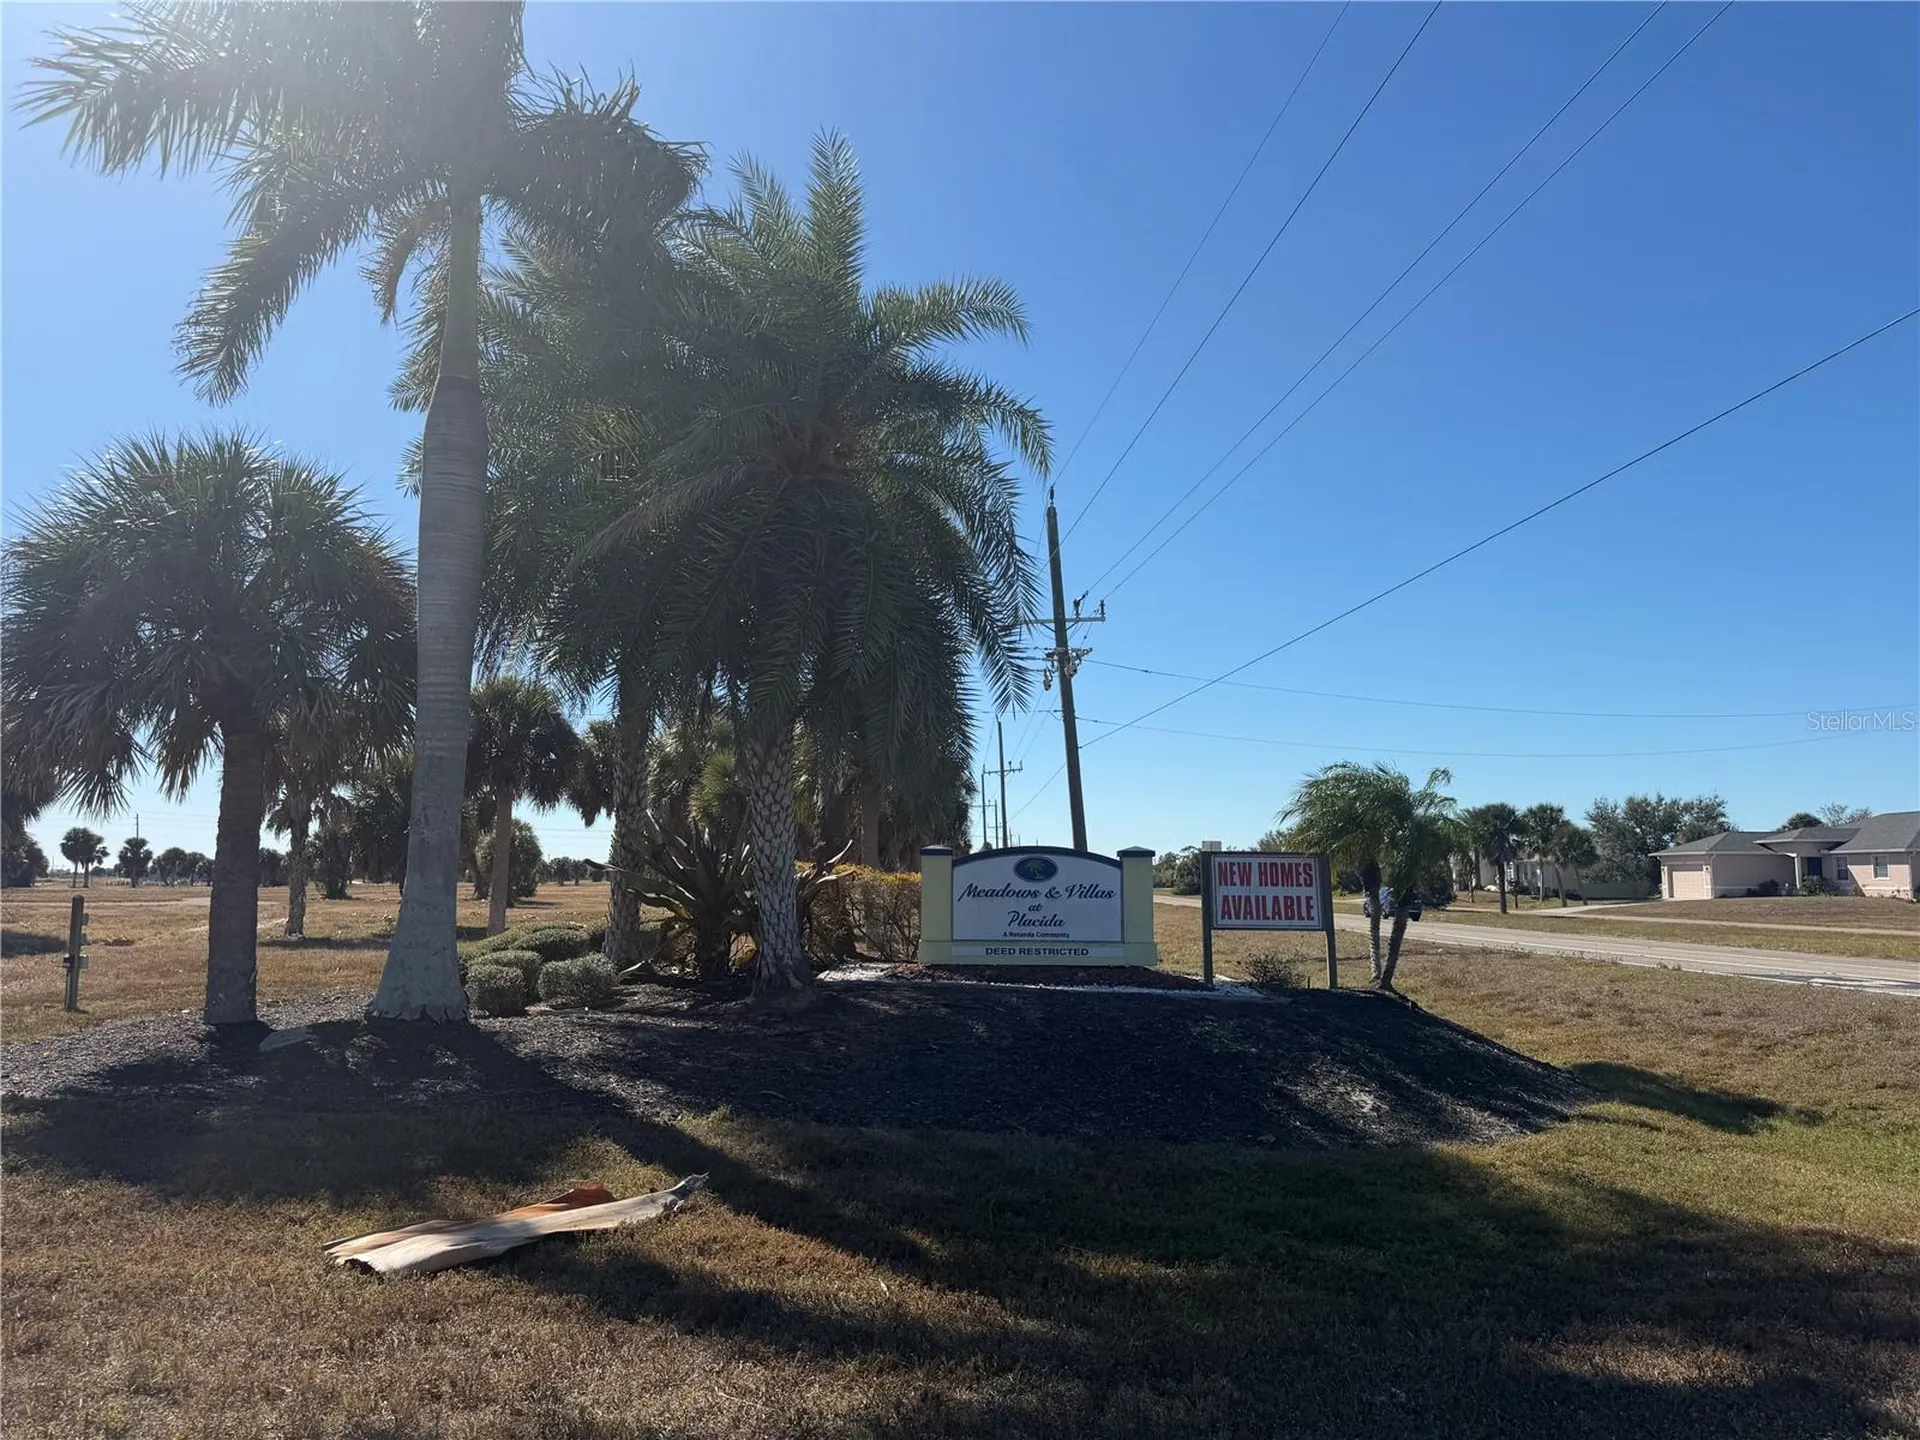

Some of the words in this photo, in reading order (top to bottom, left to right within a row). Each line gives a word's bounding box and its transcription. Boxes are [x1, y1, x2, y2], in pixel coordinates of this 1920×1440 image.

[1218, 862, 1252, 887] NEW
[1258, 862, 1313, 888] HOMES
[957, 883, 1039, 902] Meadows
[1045, 886, 1062, 899] &
[1065, 884, 1116, 899] Villas
[1028, 903, 1043, 912] at
[1221, 895, 1314, 921] AVAILABLE
[1007, 910, 1065, 927] Placida
[985, 947, 1016, 956] DEED
[1018, 948, 1089, 956] RESTRICTED
